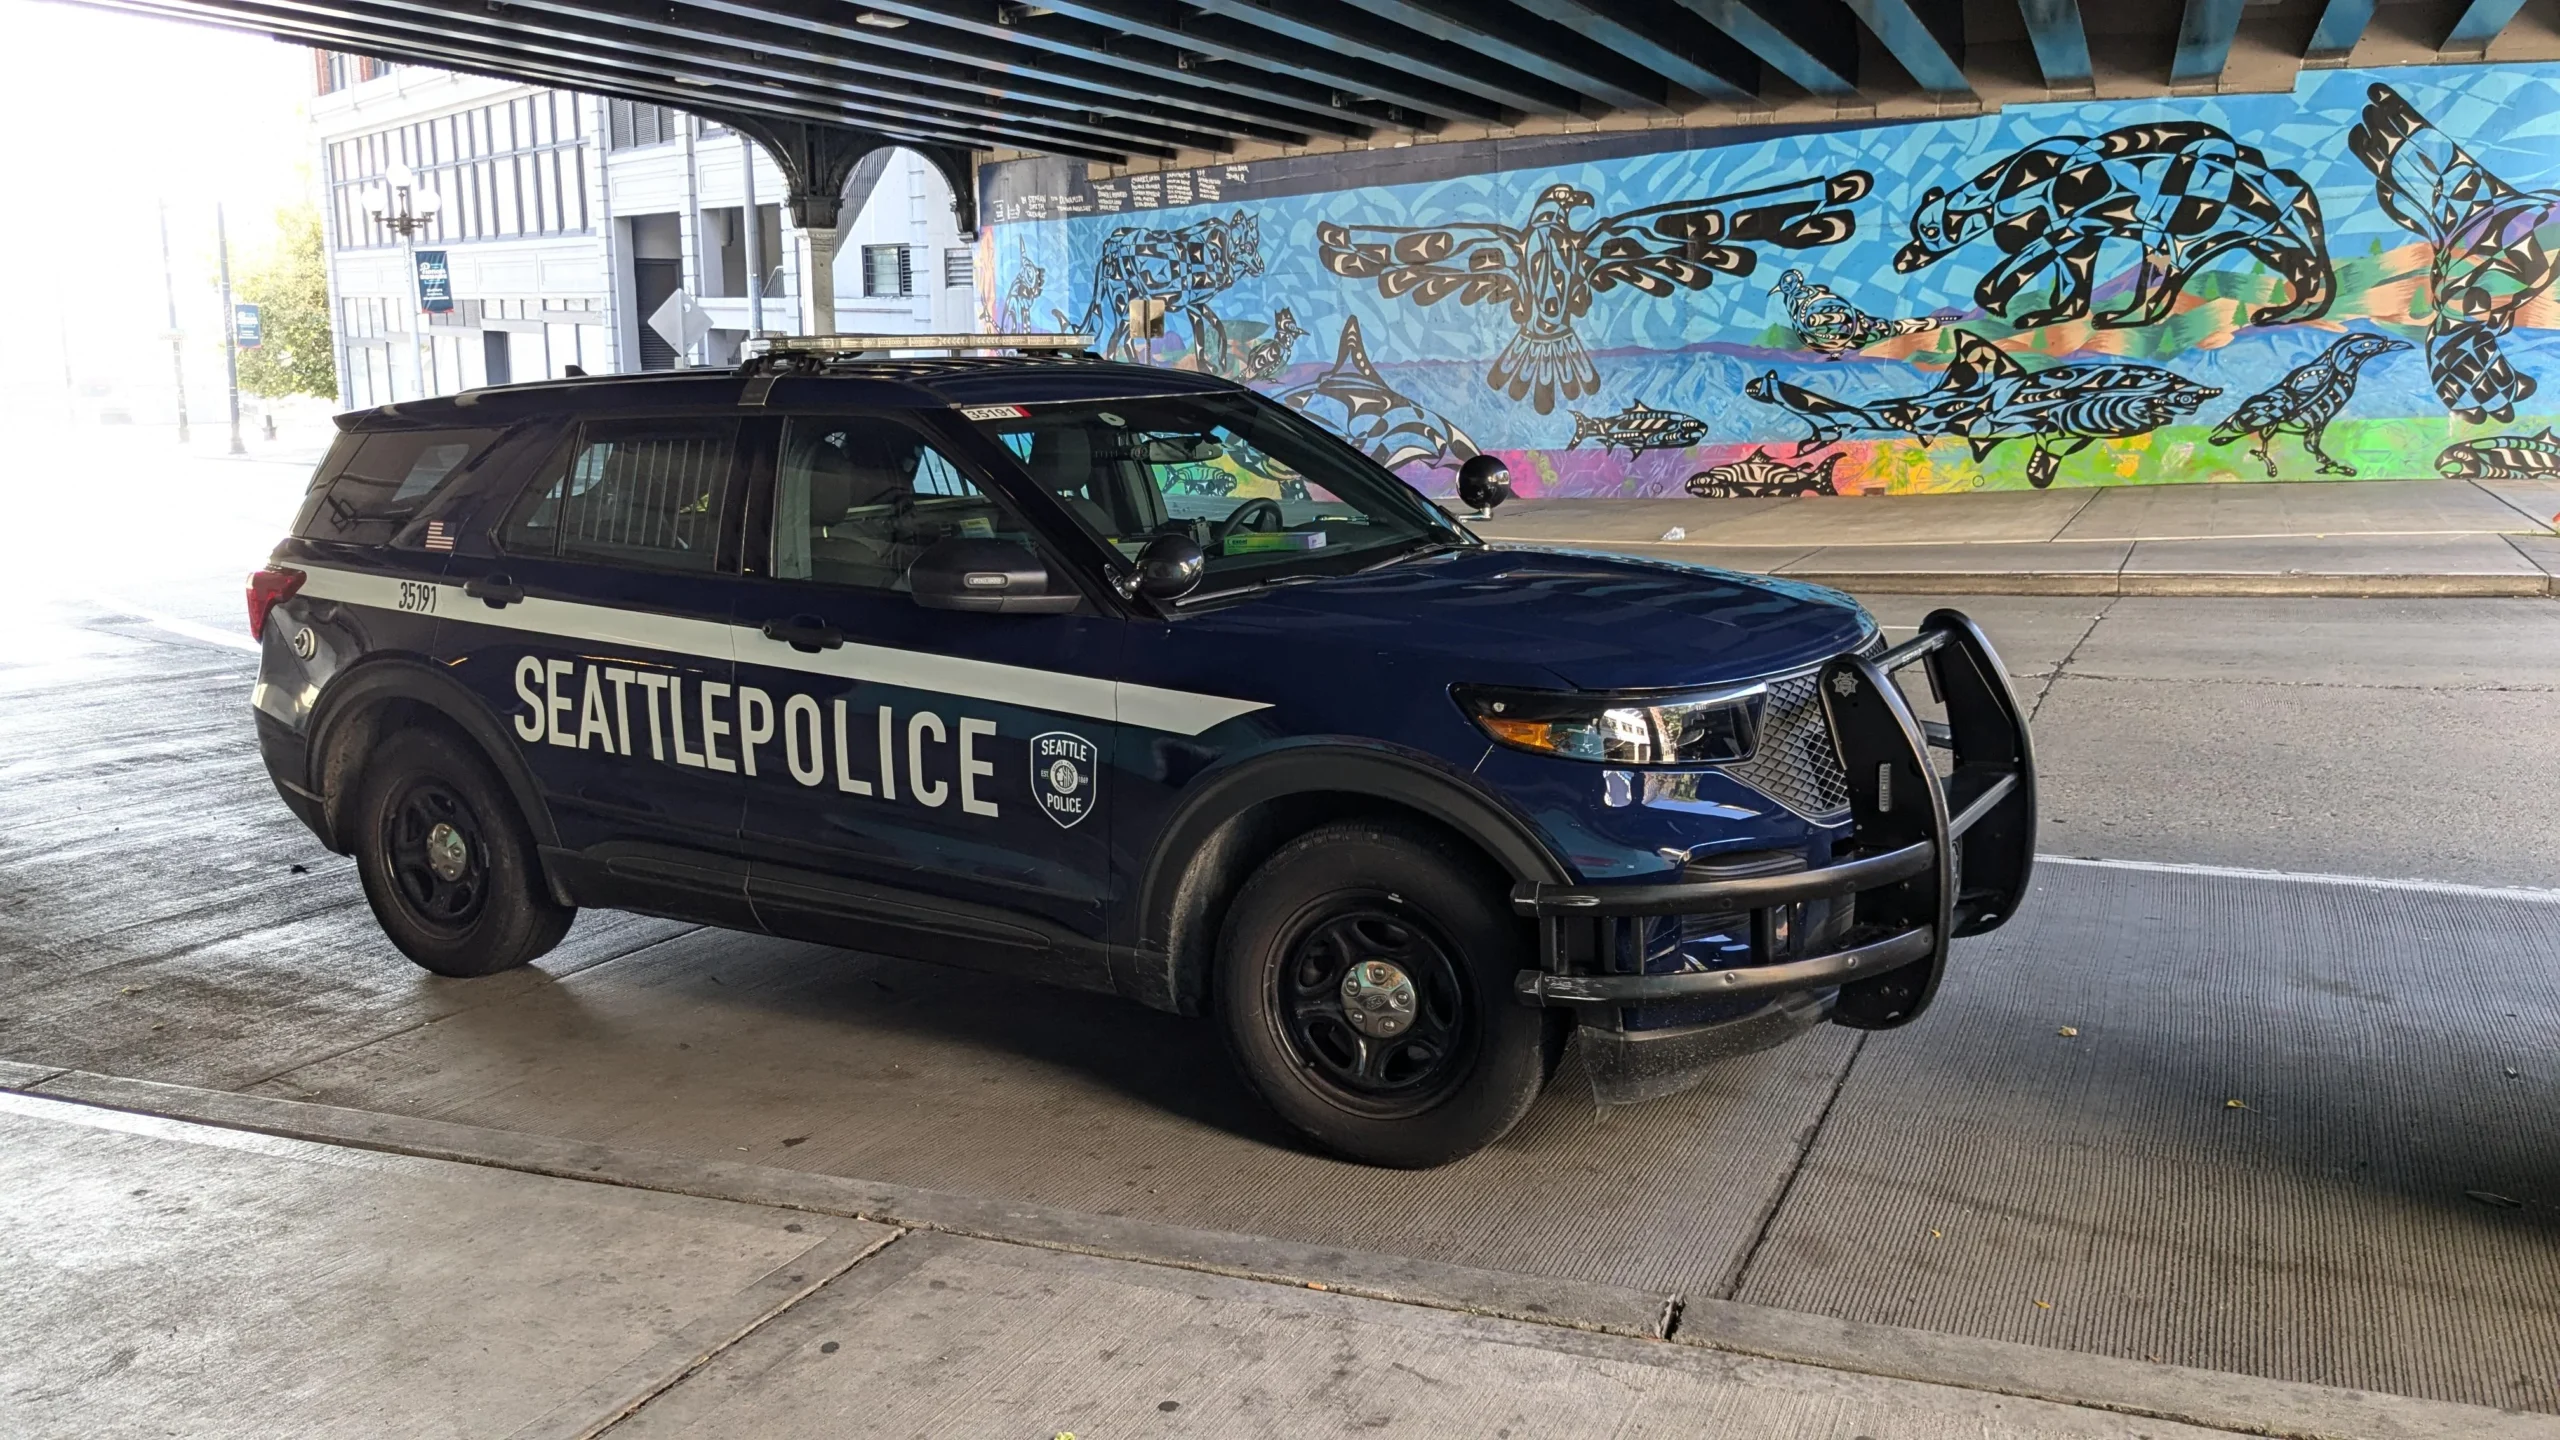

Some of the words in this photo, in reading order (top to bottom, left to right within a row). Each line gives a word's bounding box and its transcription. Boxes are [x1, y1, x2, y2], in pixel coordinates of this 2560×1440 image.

[966, 408, 1017, 419] 35191
[399, 581, 436, 613] 35191
[1041, 739, 1087, 762] SEATTLE
[1047, 793, 1082, 813] POLICE
